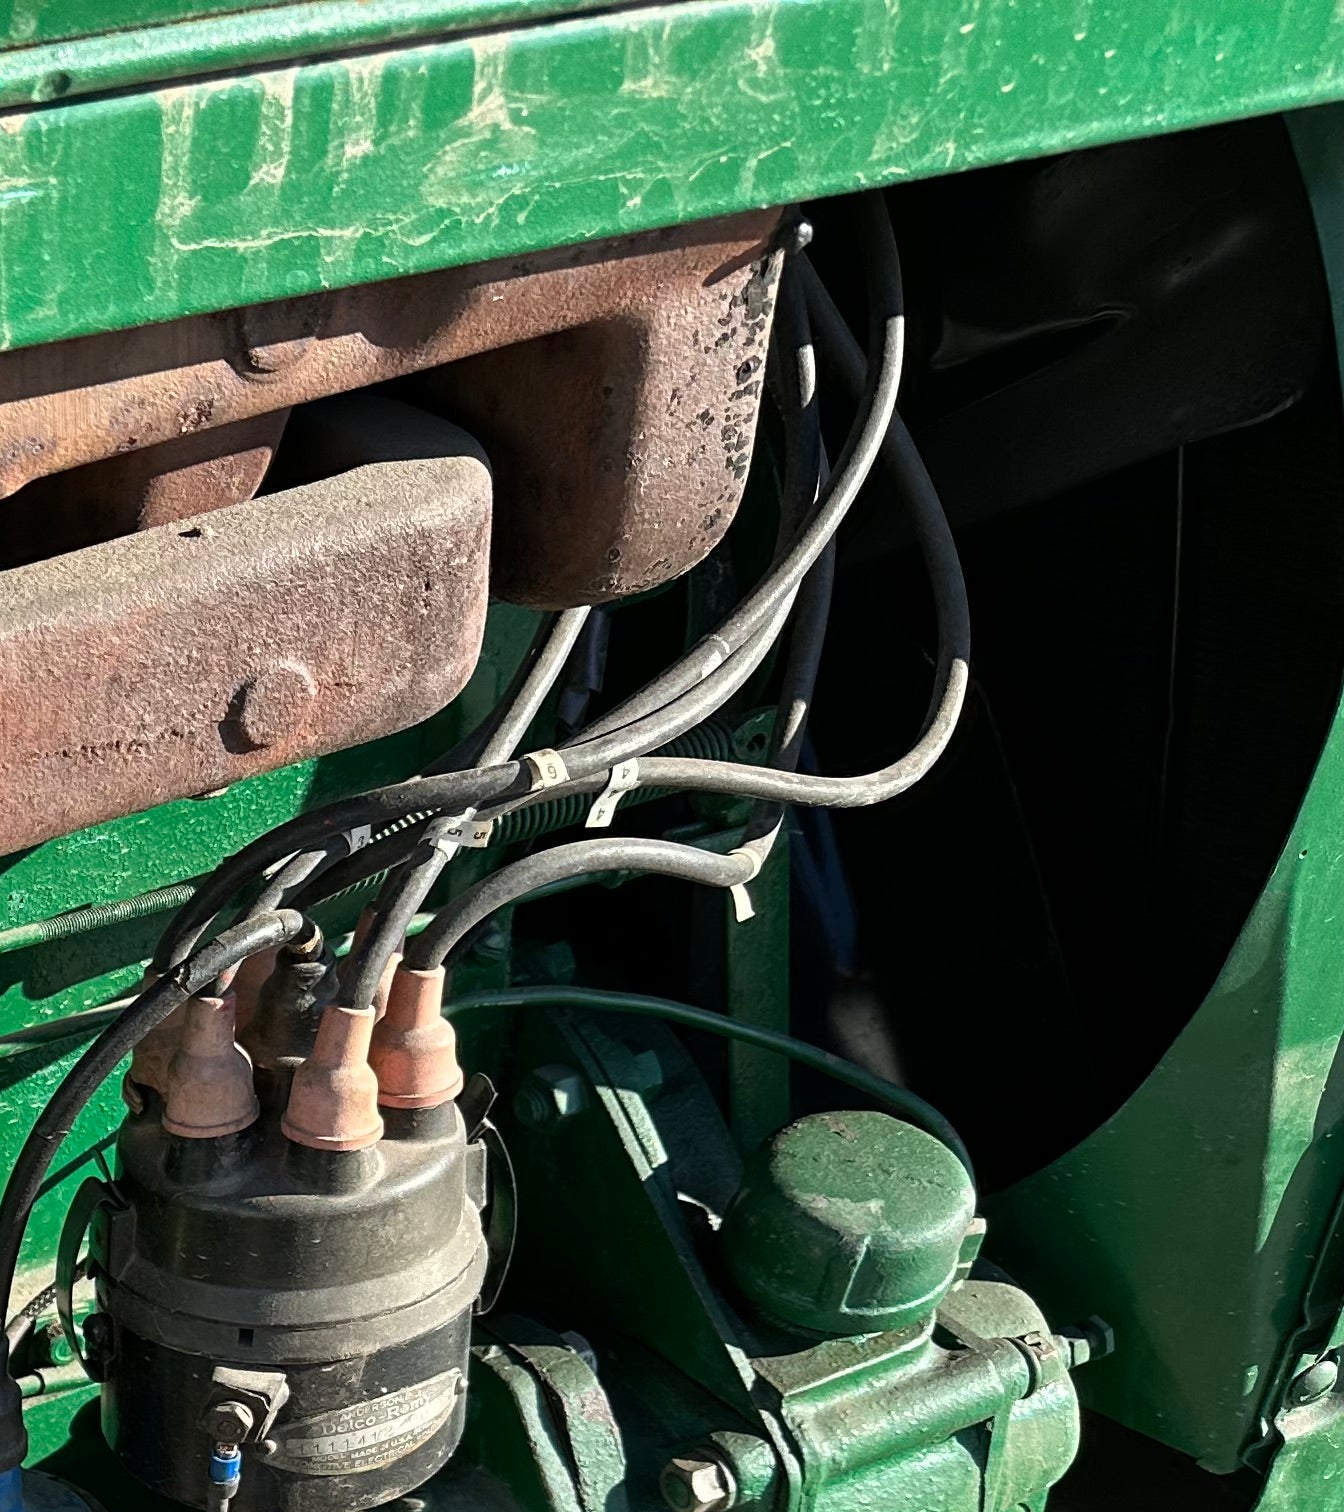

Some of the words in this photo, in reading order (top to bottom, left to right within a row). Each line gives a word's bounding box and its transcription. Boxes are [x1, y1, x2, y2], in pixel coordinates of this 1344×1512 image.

[447, 827, 463, 837] 5
[472, 831, 488, 840] 5
[321, 1391, 432, 1435] Delco-Remy
[339, 1394, 406, 1422] ANDERSON
